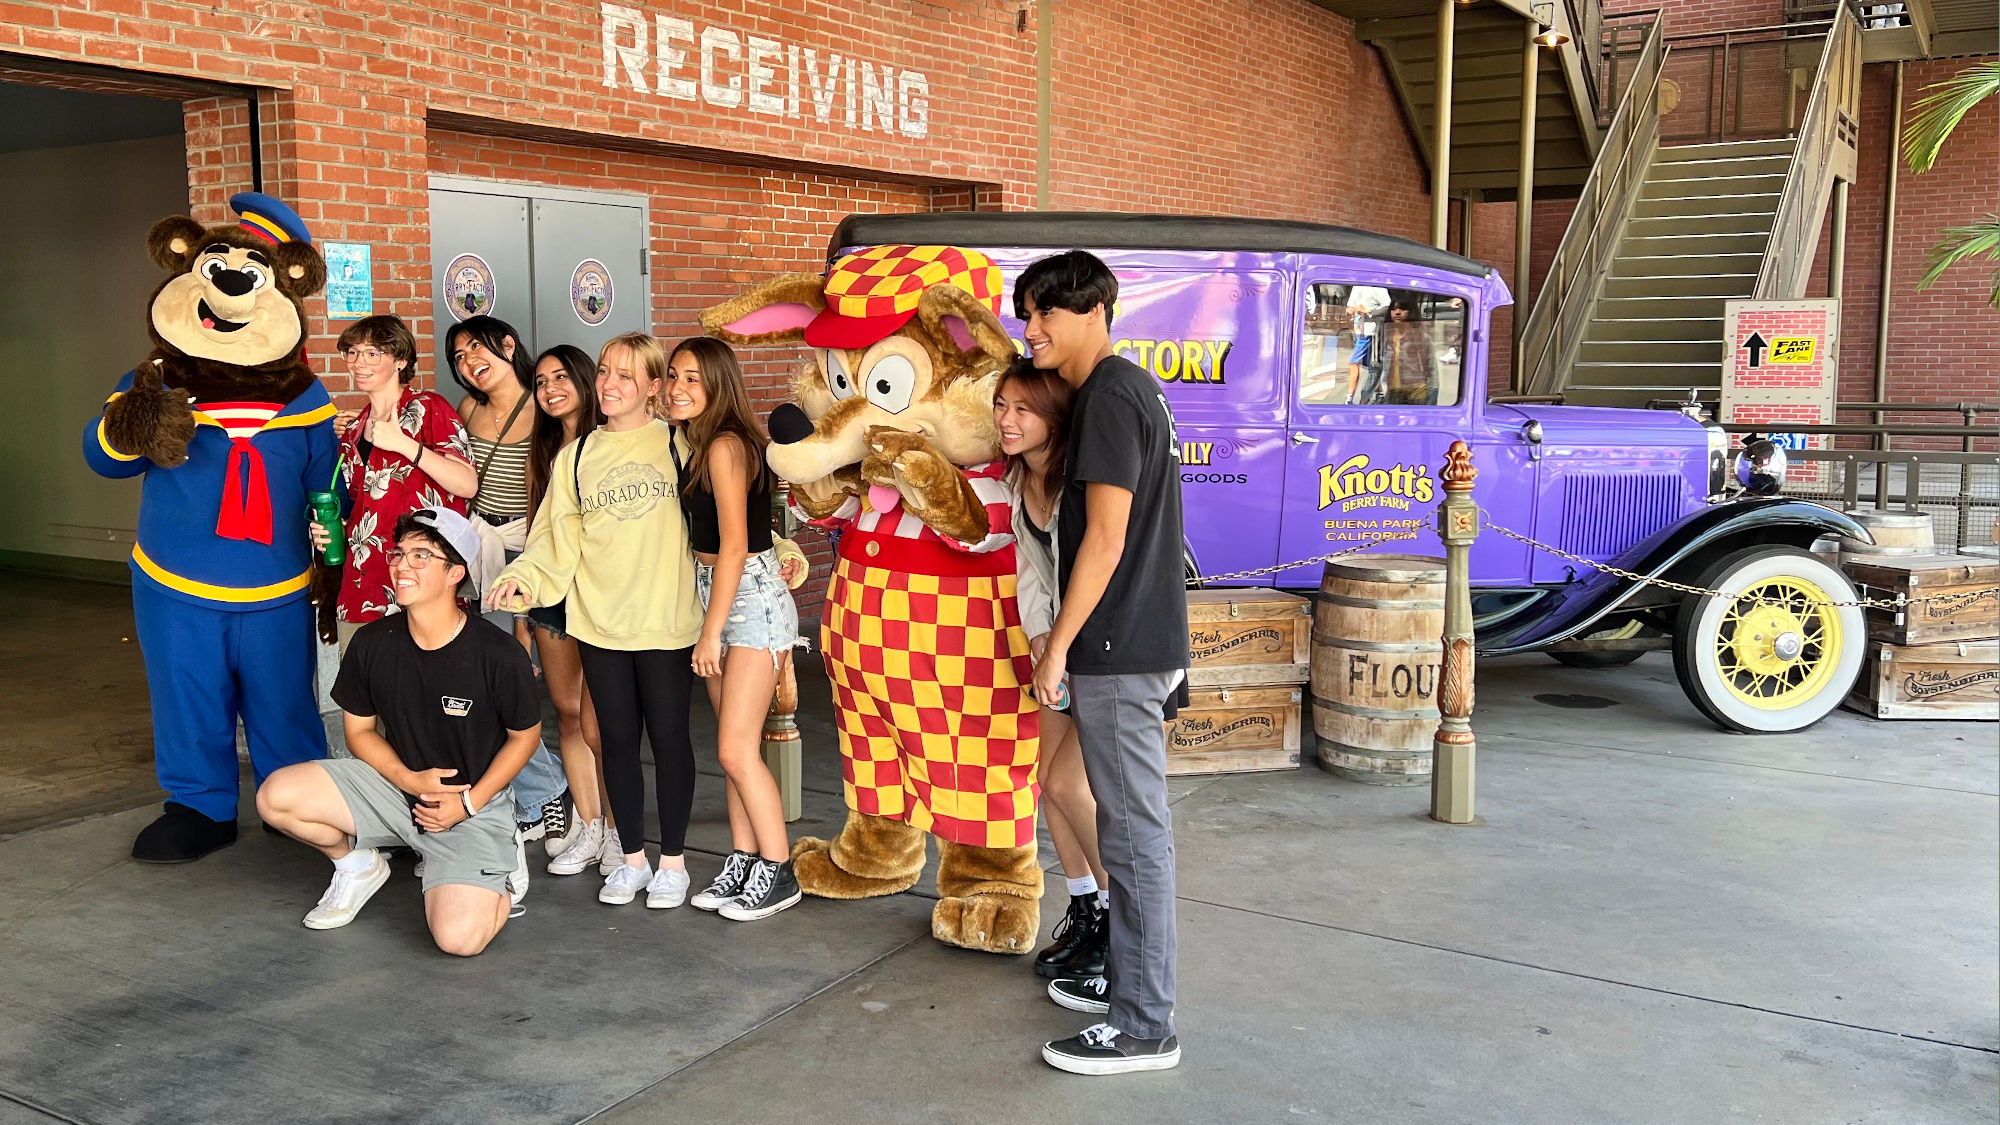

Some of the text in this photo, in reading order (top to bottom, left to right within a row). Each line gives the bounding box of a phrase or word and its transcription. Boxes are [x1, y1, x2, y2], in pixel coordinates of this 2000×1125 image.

[601, 3, 929, 139] RECEIVING
[1773, 346, 1810, 357] LANE
[1776, 340, 1811, 348] FAST
[1112, 338, 1232, 384] CTORY
[1181, 473, 1248, 484] GOODS
[1317, 453, 1434, 511] Knott's
[582, 482, 648, 513] OLORADO
[1341, 495, 1410, 513] BERRY FARM
[1324, 519, 1422, 529] BUENA PARK
[1325, 531, 1418, 541] CALIFORNIA
[1188, 629, 1280, 659] OYSENBERRIES
[1190, 630, 1222, 645] Fresh
[1348, 653, 1443, 699] FLOU
[1918, 670, 1951, 682] Fresh
[1174, 716, 1270, 747] BOYSENBERRIES
[1181, 716, 1213, 732] Fresh
